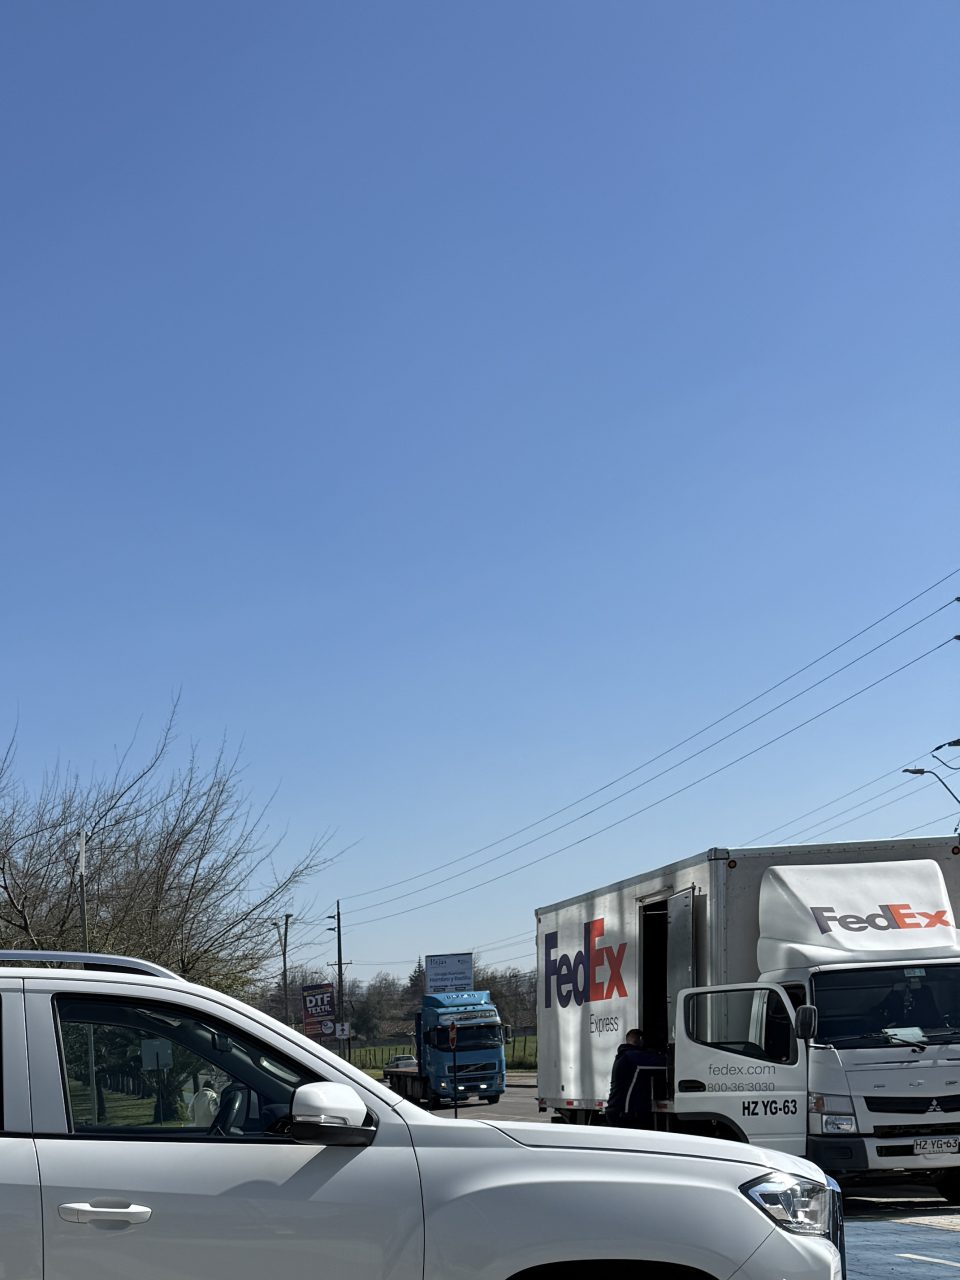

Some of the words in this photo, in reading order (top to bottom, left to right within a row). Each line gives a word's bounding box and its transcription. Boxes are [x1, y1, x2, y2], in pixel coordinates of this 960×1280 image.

[809, 903, 952, 935] FedEx
[544, 917, 629, 1009] FedEx
[305, 993, 331, 1008] DTF
[307, 1005, 332, 1015] TEXTIL
[589, 1013, 619, 1037] Express
[708, 1063, 776, 1076] fedex.com
[742, 1100, 759, 1116] HZ
[761, 1099, 798, 1116] YG-63
[915, 1140, 928, 1150] HZ
[930, 1139, 958, 1149] YG-63
